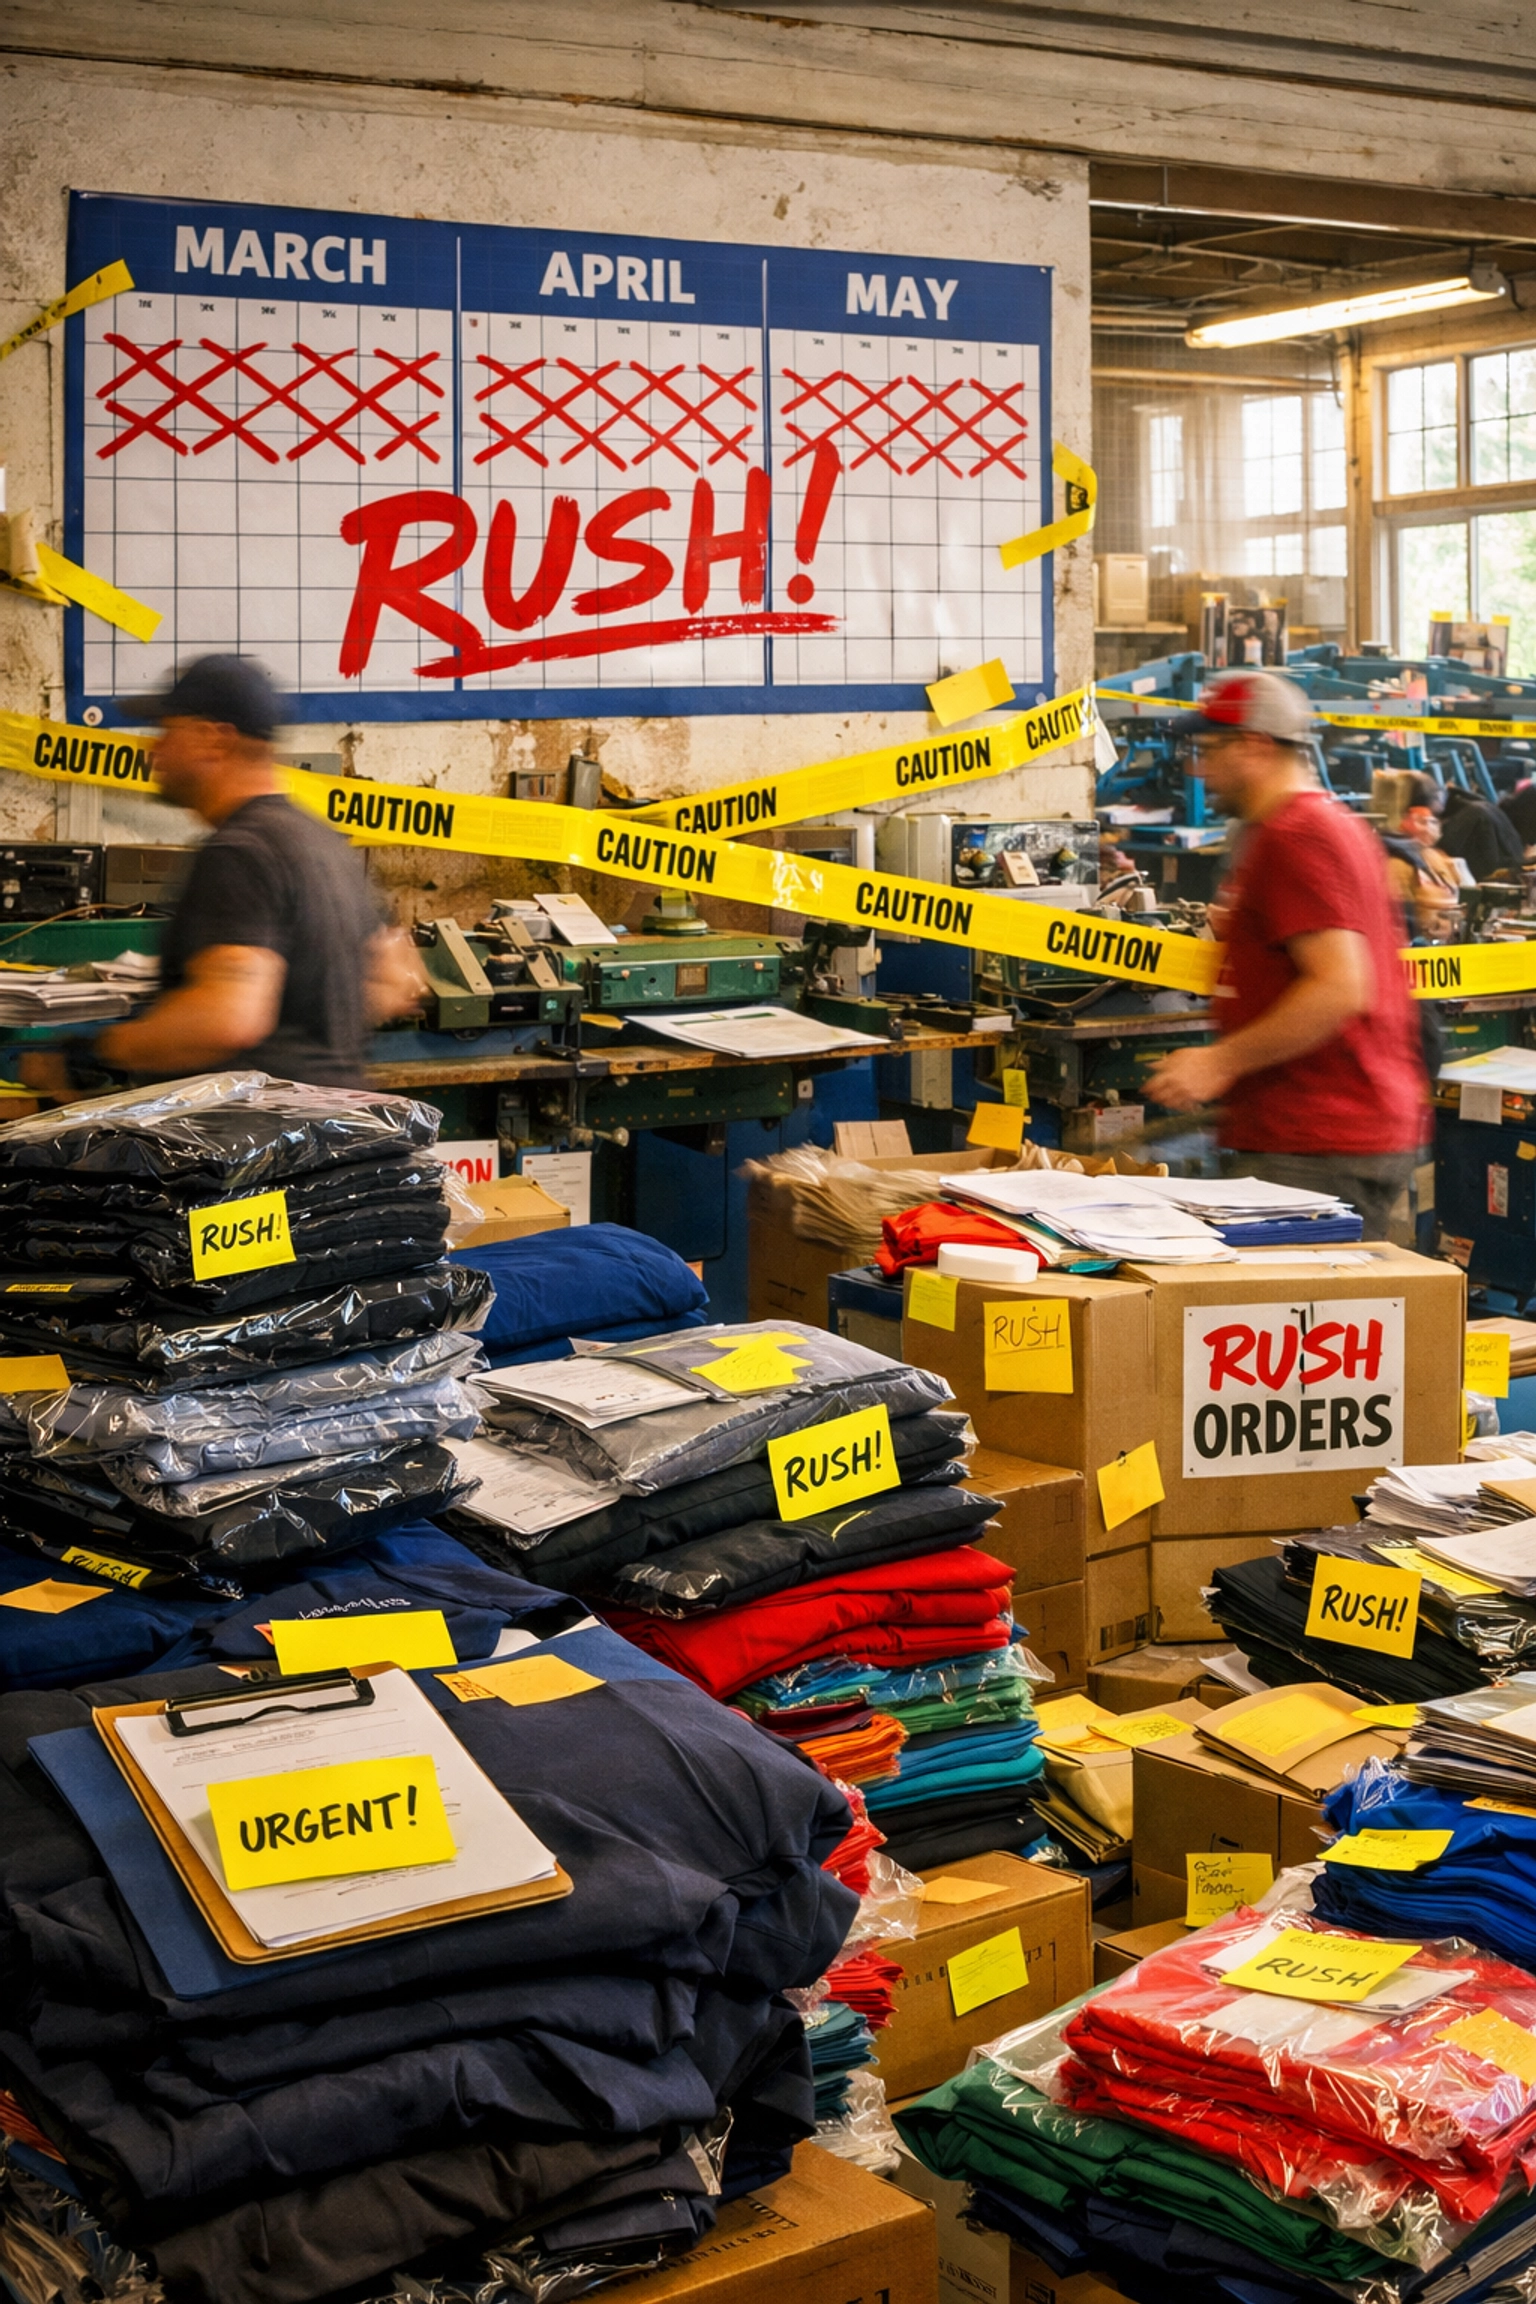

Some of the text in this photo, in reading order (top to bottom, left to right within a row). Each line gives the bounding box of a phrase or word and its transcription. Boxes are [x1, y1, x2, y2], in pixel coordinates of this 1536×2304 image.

[174, 225, 387, 285] MARCH
[540, 251, 695, 304] APRIL
[845, 273, 958, 320] MAY
[339, 439, 843, 677] RUSH!
[1026, 697, 1091, 751] CAUTI
[34, 732, 154, 783] CAUTION
[896, 737, 991, 787] CAUTION
[328, 789, 454, 838] CAUTION
[676, 786, 778, 835] CAUTION
[597, 829, 717, 884] CAUTION
[856, 882, 973, 935] CAUTION
[1046, 921, 1162, 973] CAUTION
[1405, 957, 1461, 989] UTION
[200, 1212, 282, 1256] RUSH!
[992, 1310, 1060, 1350] RUSH
[1203, 1319, 1383, 1390] RUSH
[1194, 1394, 1392, 1459] ORDERS
[784, 1430, 882, 1498] RUSH!
[1320, 1584, 1408, 1632] RUSH!
[239, 1785, 419, 1852] URGENT!
[1256, 1957, 1378, 1987] RUSH
